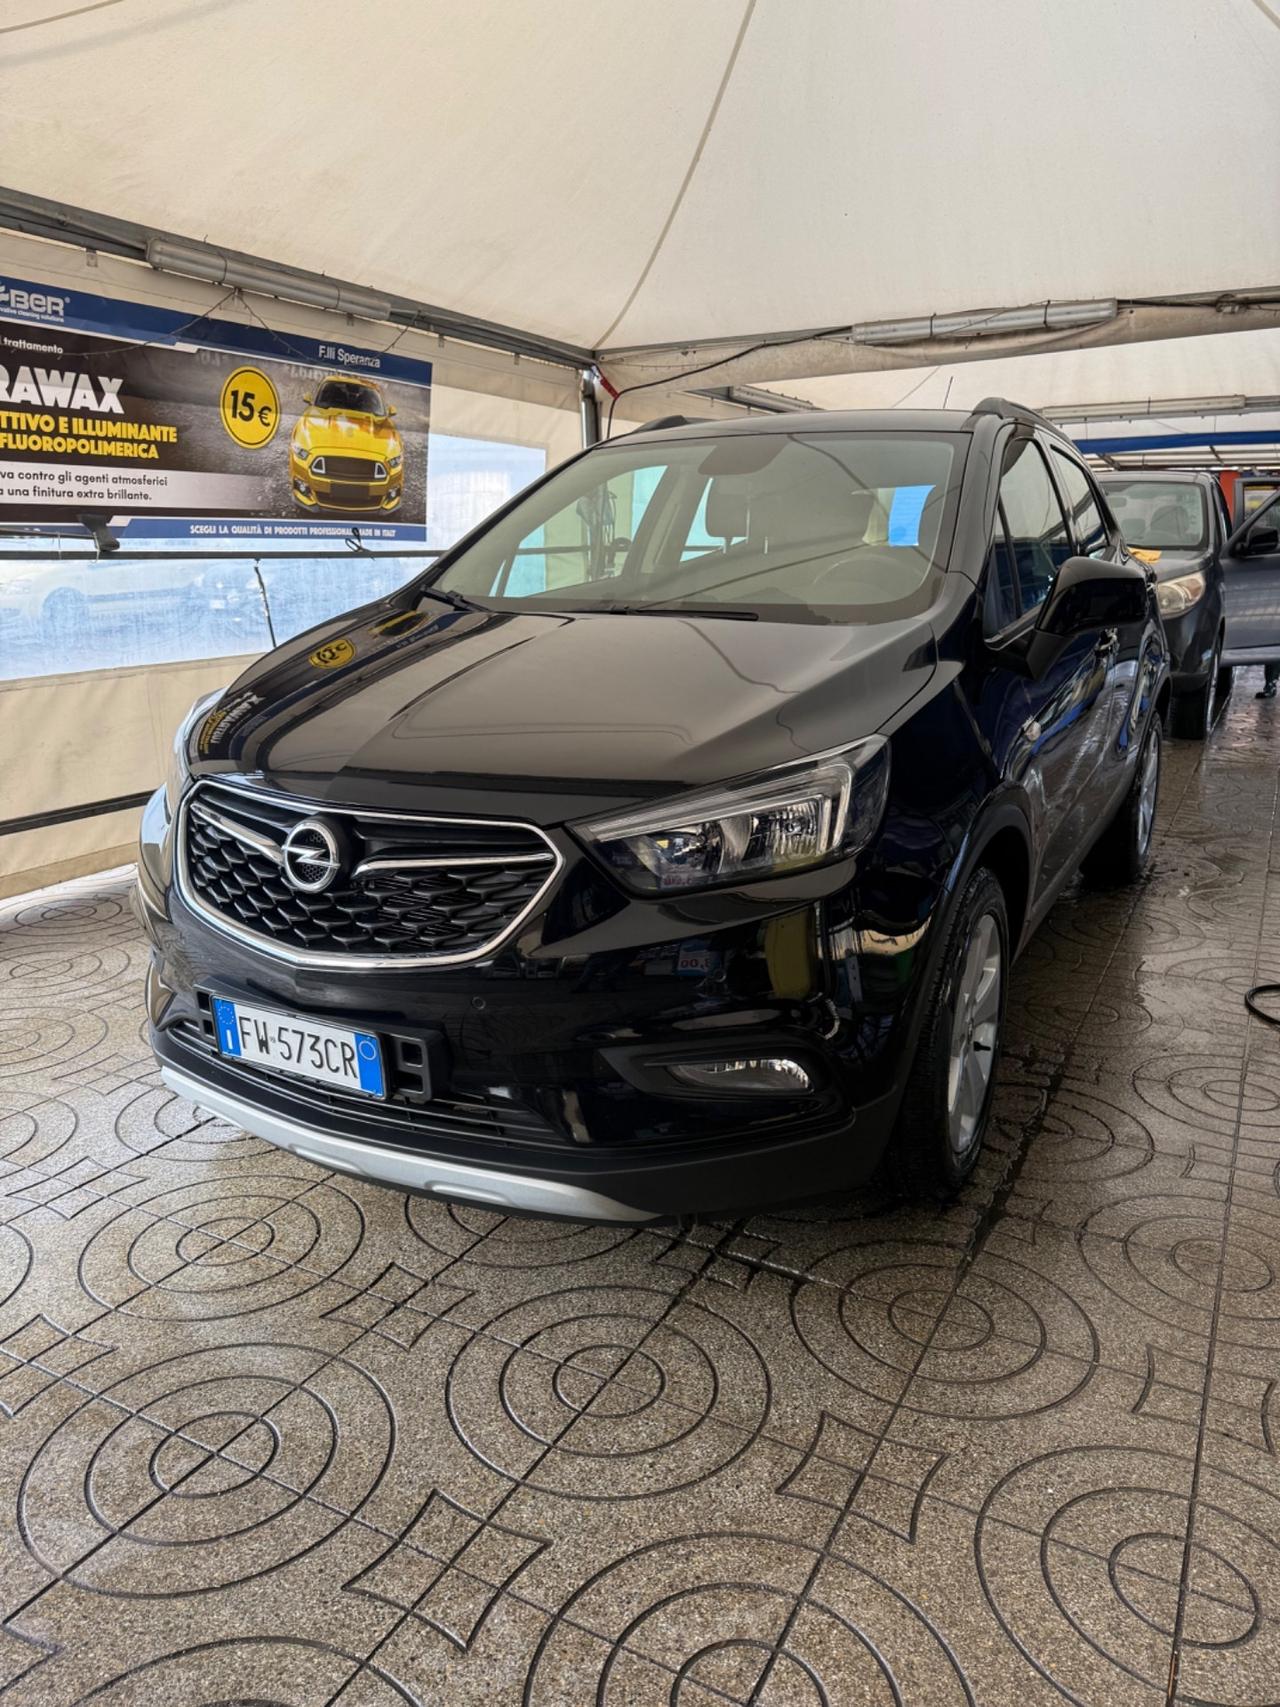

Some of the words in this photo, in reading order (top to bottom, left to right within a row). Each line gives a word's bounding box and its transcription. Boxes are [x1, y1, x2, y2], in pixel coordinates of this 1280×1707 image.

[4, 337, 64, 355] trattamento
[337, 348, 380, 368] Speranza
[59, 416, 69, 434] E
[73, 417, 178, 443] ILLUMINANTE
[0, 432, 159, 459] FLUOROPOLIMERICA
[18, 470, 55, 481] contro
[58, 471, 72, 485] gli
[75, 473, 109, 486] agenti
[112, 474, 168, 486] atmosferici
[8, 487, 29, 497] una
[33, 486, 74, 498] finitura
[77, 490, 104, 499] extra
[107, 489, 152, 500] brillante.
[190, 525, 216, 534] SCEGLI
[219, 525, 229, 534] LA
[231, 524, 262, 535] QUALITÀ
[264, 526, 272, 535] DI
[274, 526, 308, 536] PRODOTTI
